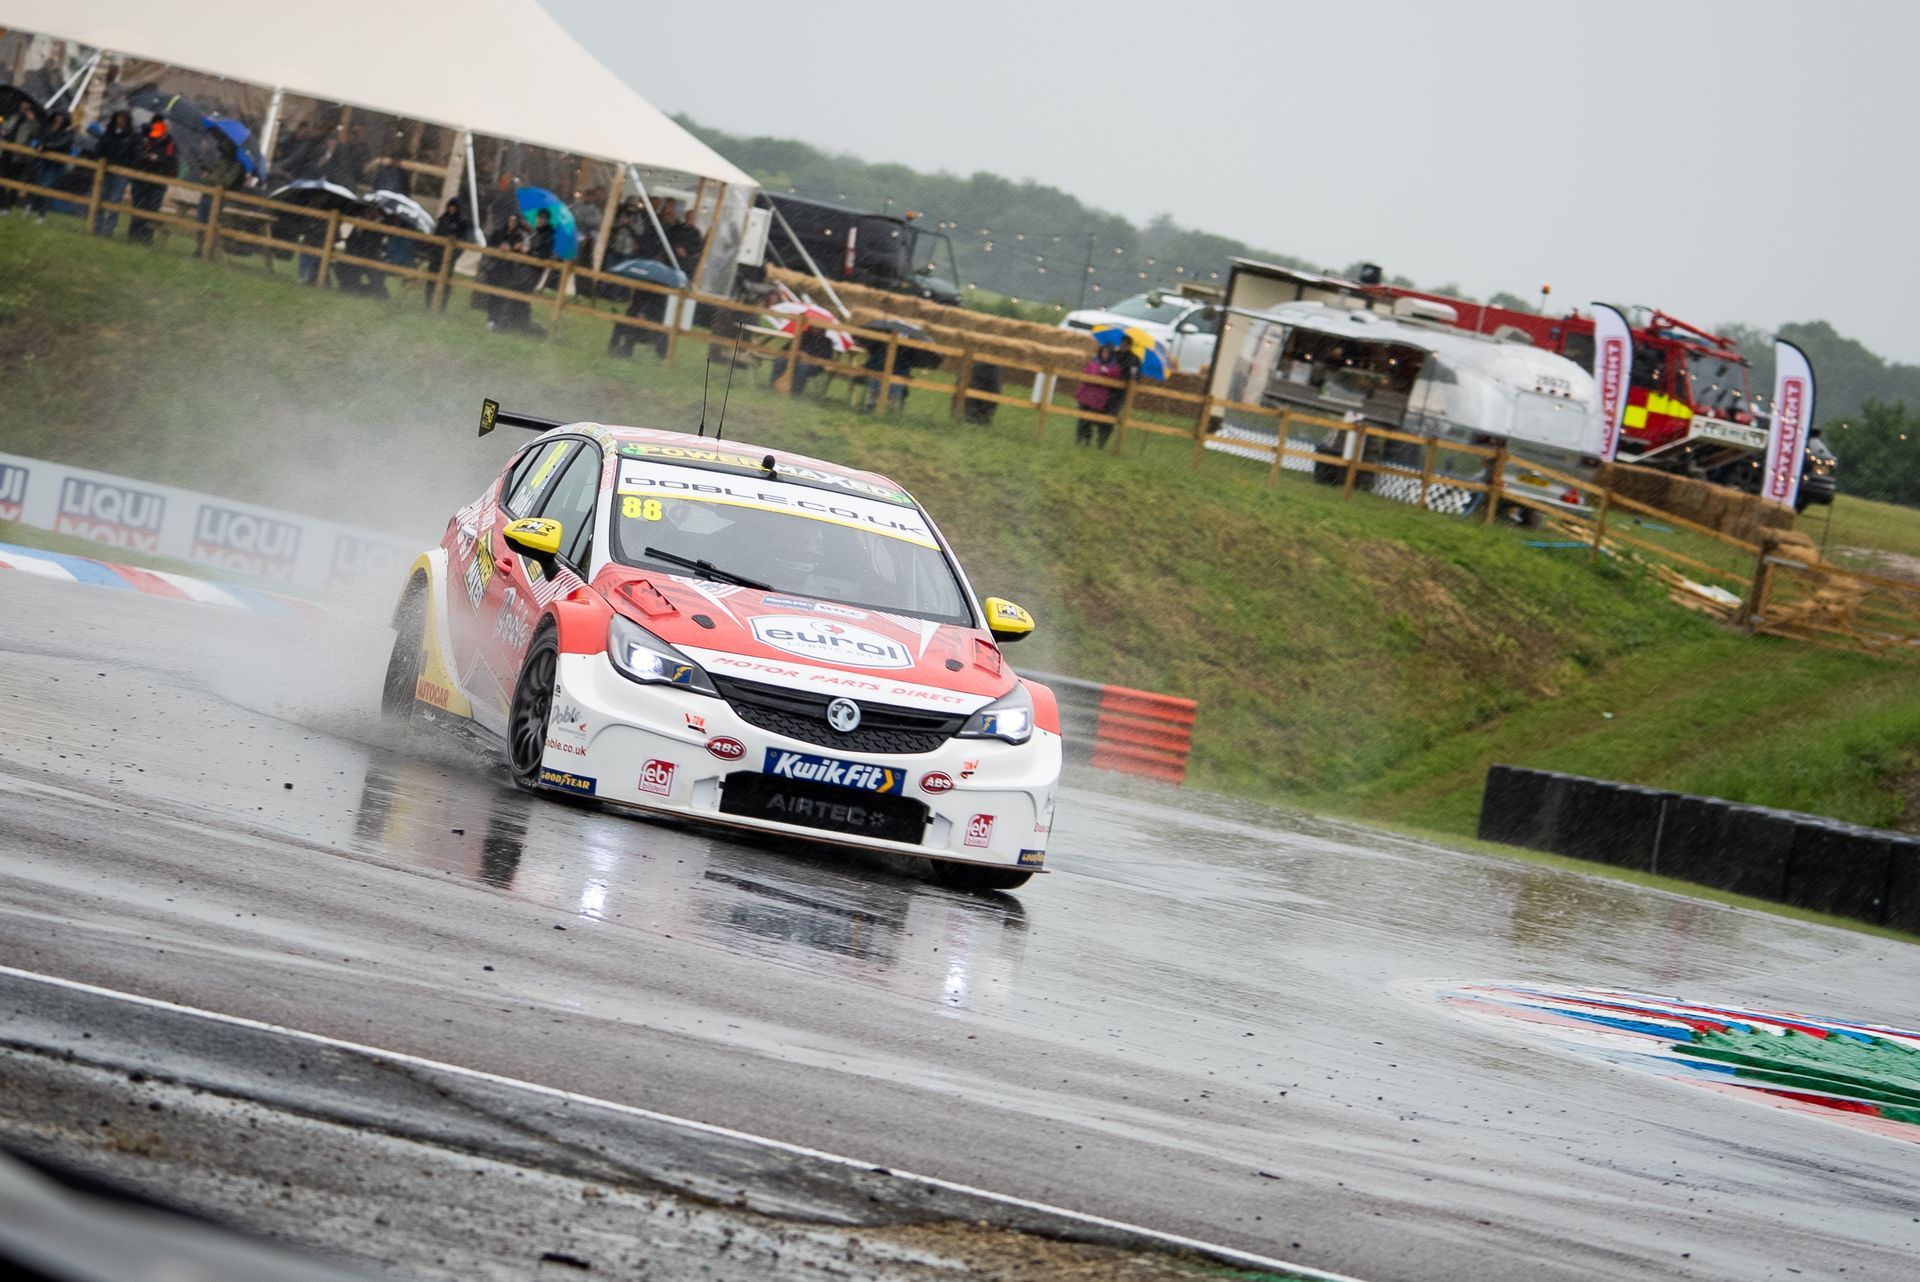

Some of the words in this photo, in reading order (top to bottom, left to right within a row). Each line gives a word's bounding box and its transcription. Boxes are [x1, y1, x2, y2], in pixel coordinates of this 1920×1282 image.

[62, 479, 164, 529] LIQUI
[622, 496, 662, 521] 88
[625, 476, 925, 537] DOBLE.CO.UK
[201, 508, 297, 559] LIQUI
[765, 628, 898, 660] eurol
[416, 679, 450, 709] AUTOCAR
[711, 657, 799, 678] MOTOR
[809, 674, 881, 692] PARTS
[890, 687, 966, 705] DIRECT
[545, 736, 587, 757] oble.co.uk
[711, 741, 741, 755] ABS
[541, 771, 591, 790] GOODYEAR
[640, 760, 673, 786] febi
[924, 776, 951, 789] ABS
[766, 793, 867, 826] AIRTEC
[967, 815, 993, 838] febi
